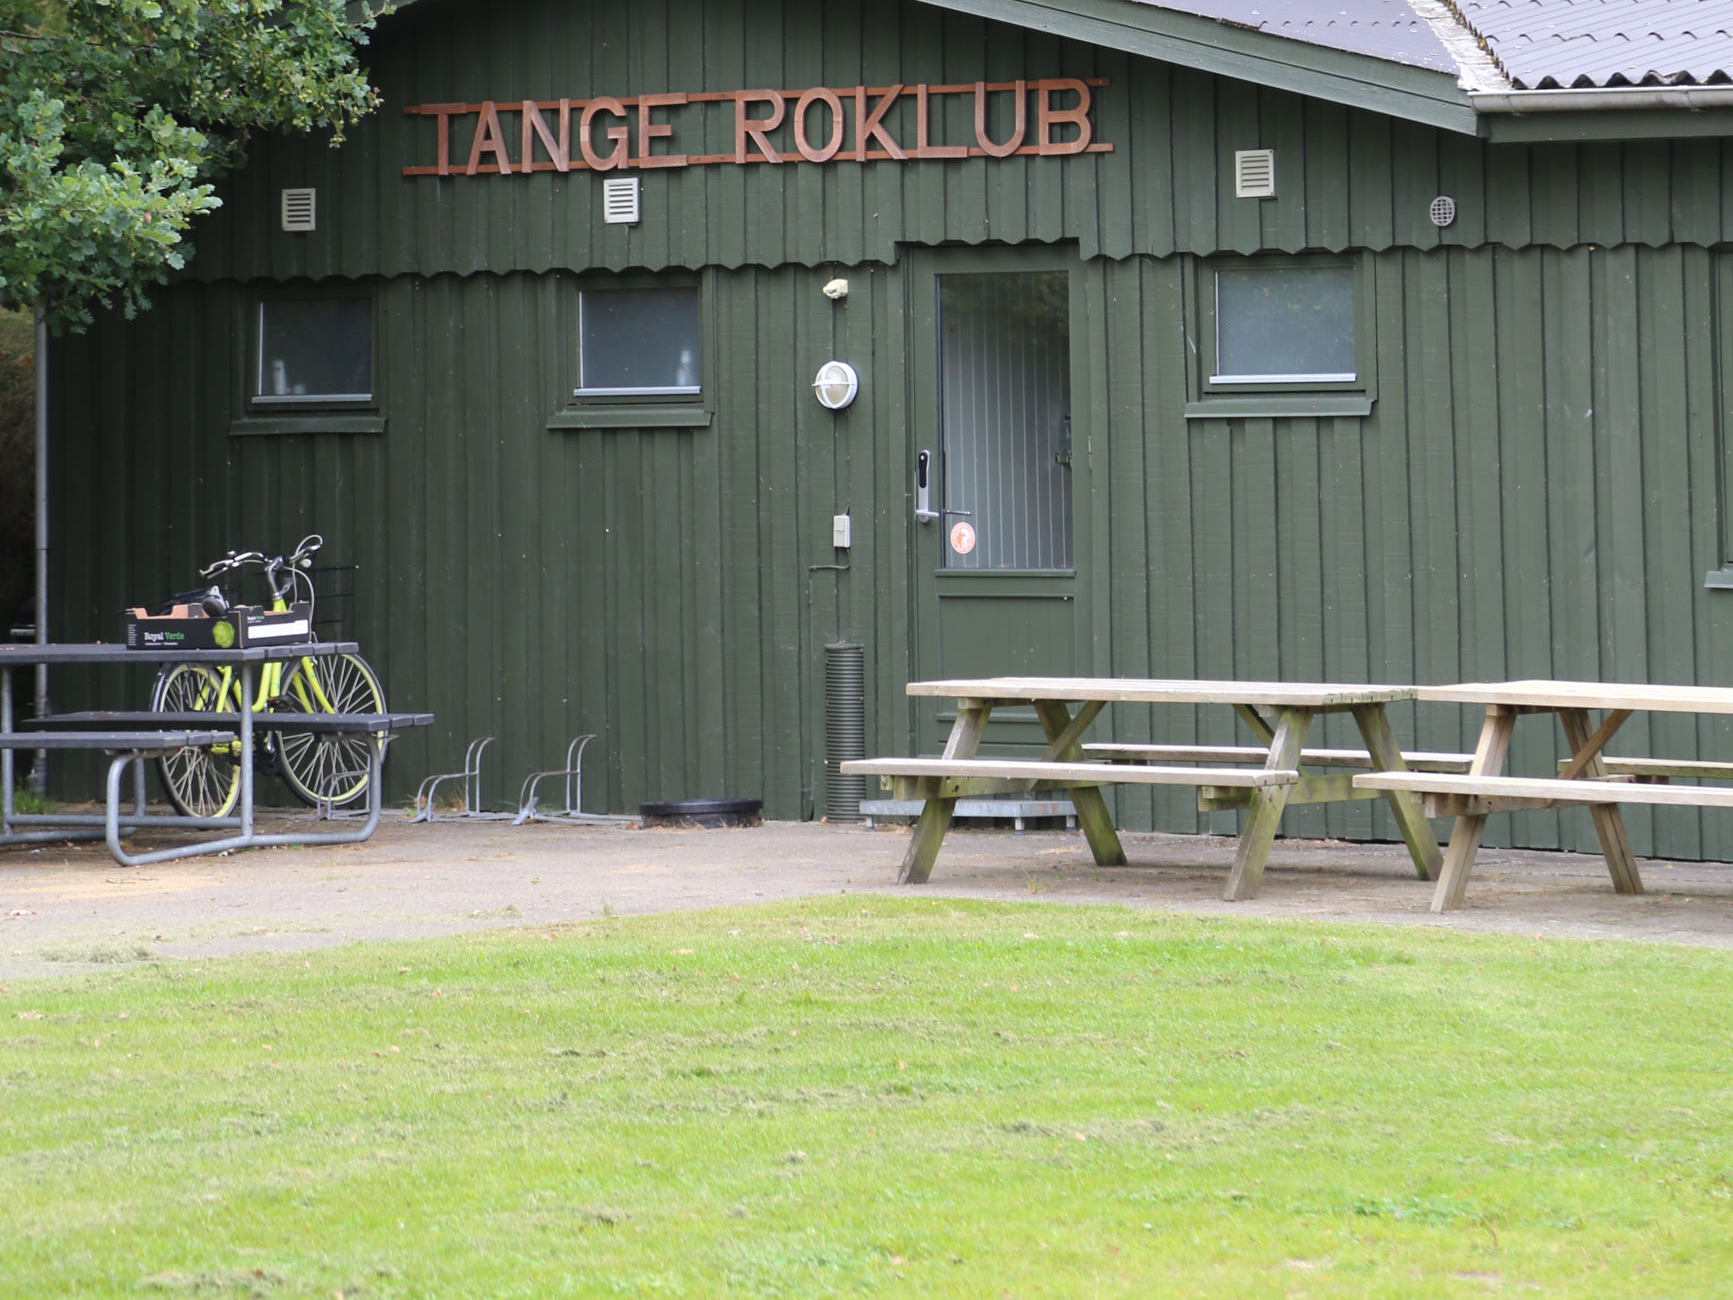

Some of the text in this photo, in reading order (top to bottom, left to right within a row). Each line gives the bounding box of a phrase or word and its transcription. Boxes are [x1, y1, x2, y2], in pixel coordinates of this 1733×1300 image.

[420, 78, 1092, 176] TANGE ROKLUB
[144, 632, 164, 642] Royal
[164, 631, 185, 640] Verde
